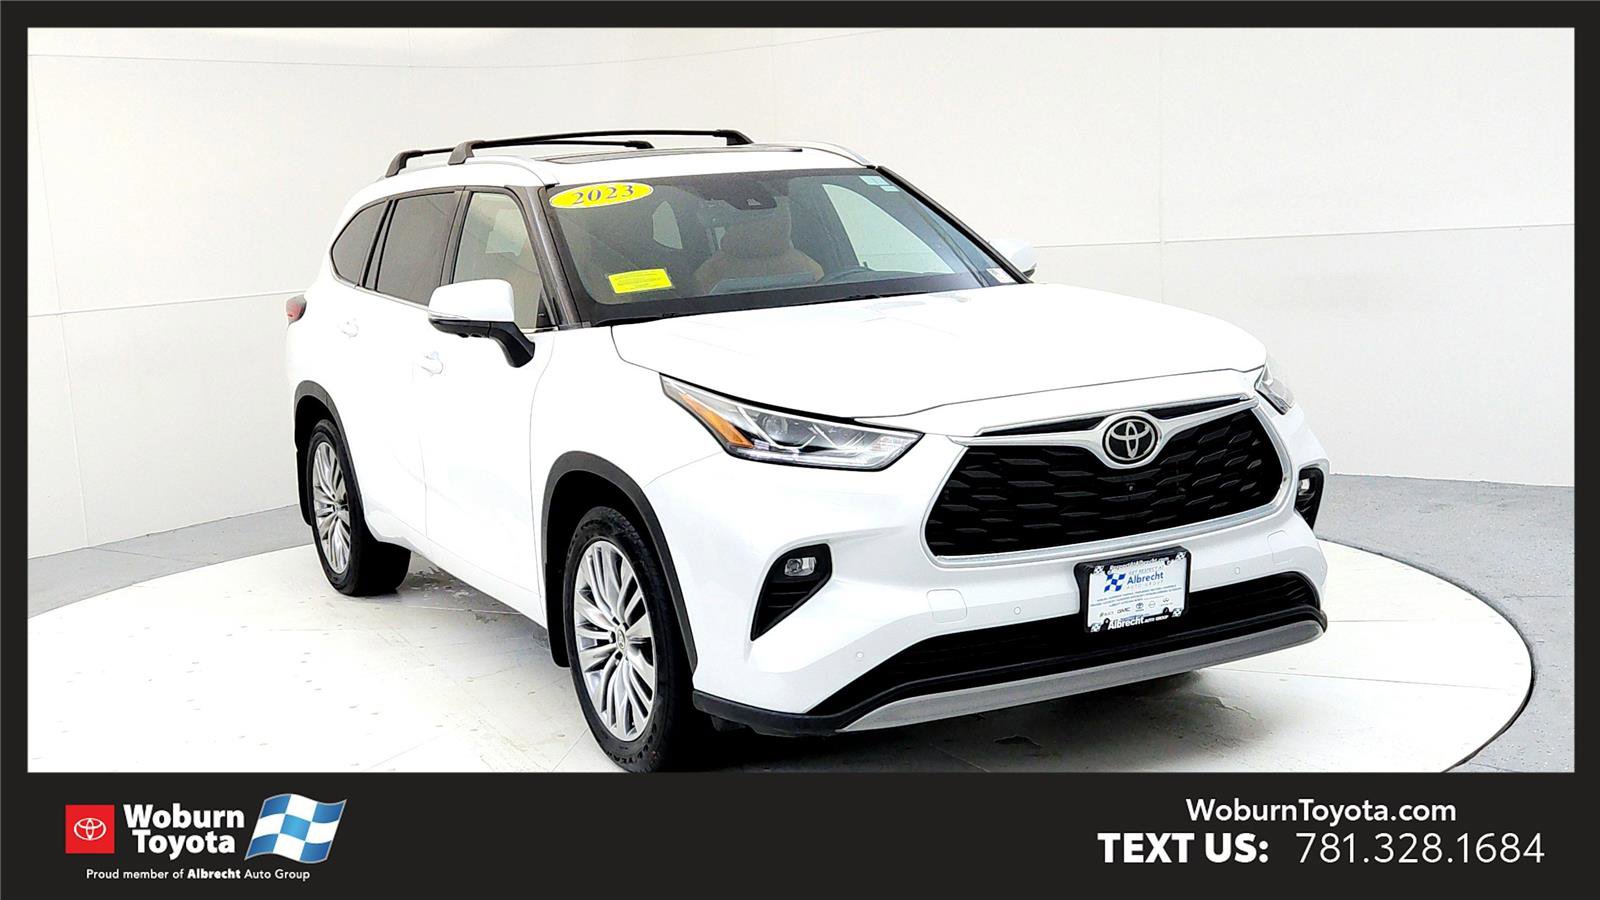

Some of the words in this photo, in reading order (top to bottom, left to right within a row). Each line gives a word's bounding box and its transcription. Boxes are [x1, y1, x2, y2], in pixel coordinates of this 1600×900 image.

[573, 184, 634, 204] 2023
[1127, 571, 1164, 584] Albrecht
[1107, 616, 1145, 630] Albrecht
